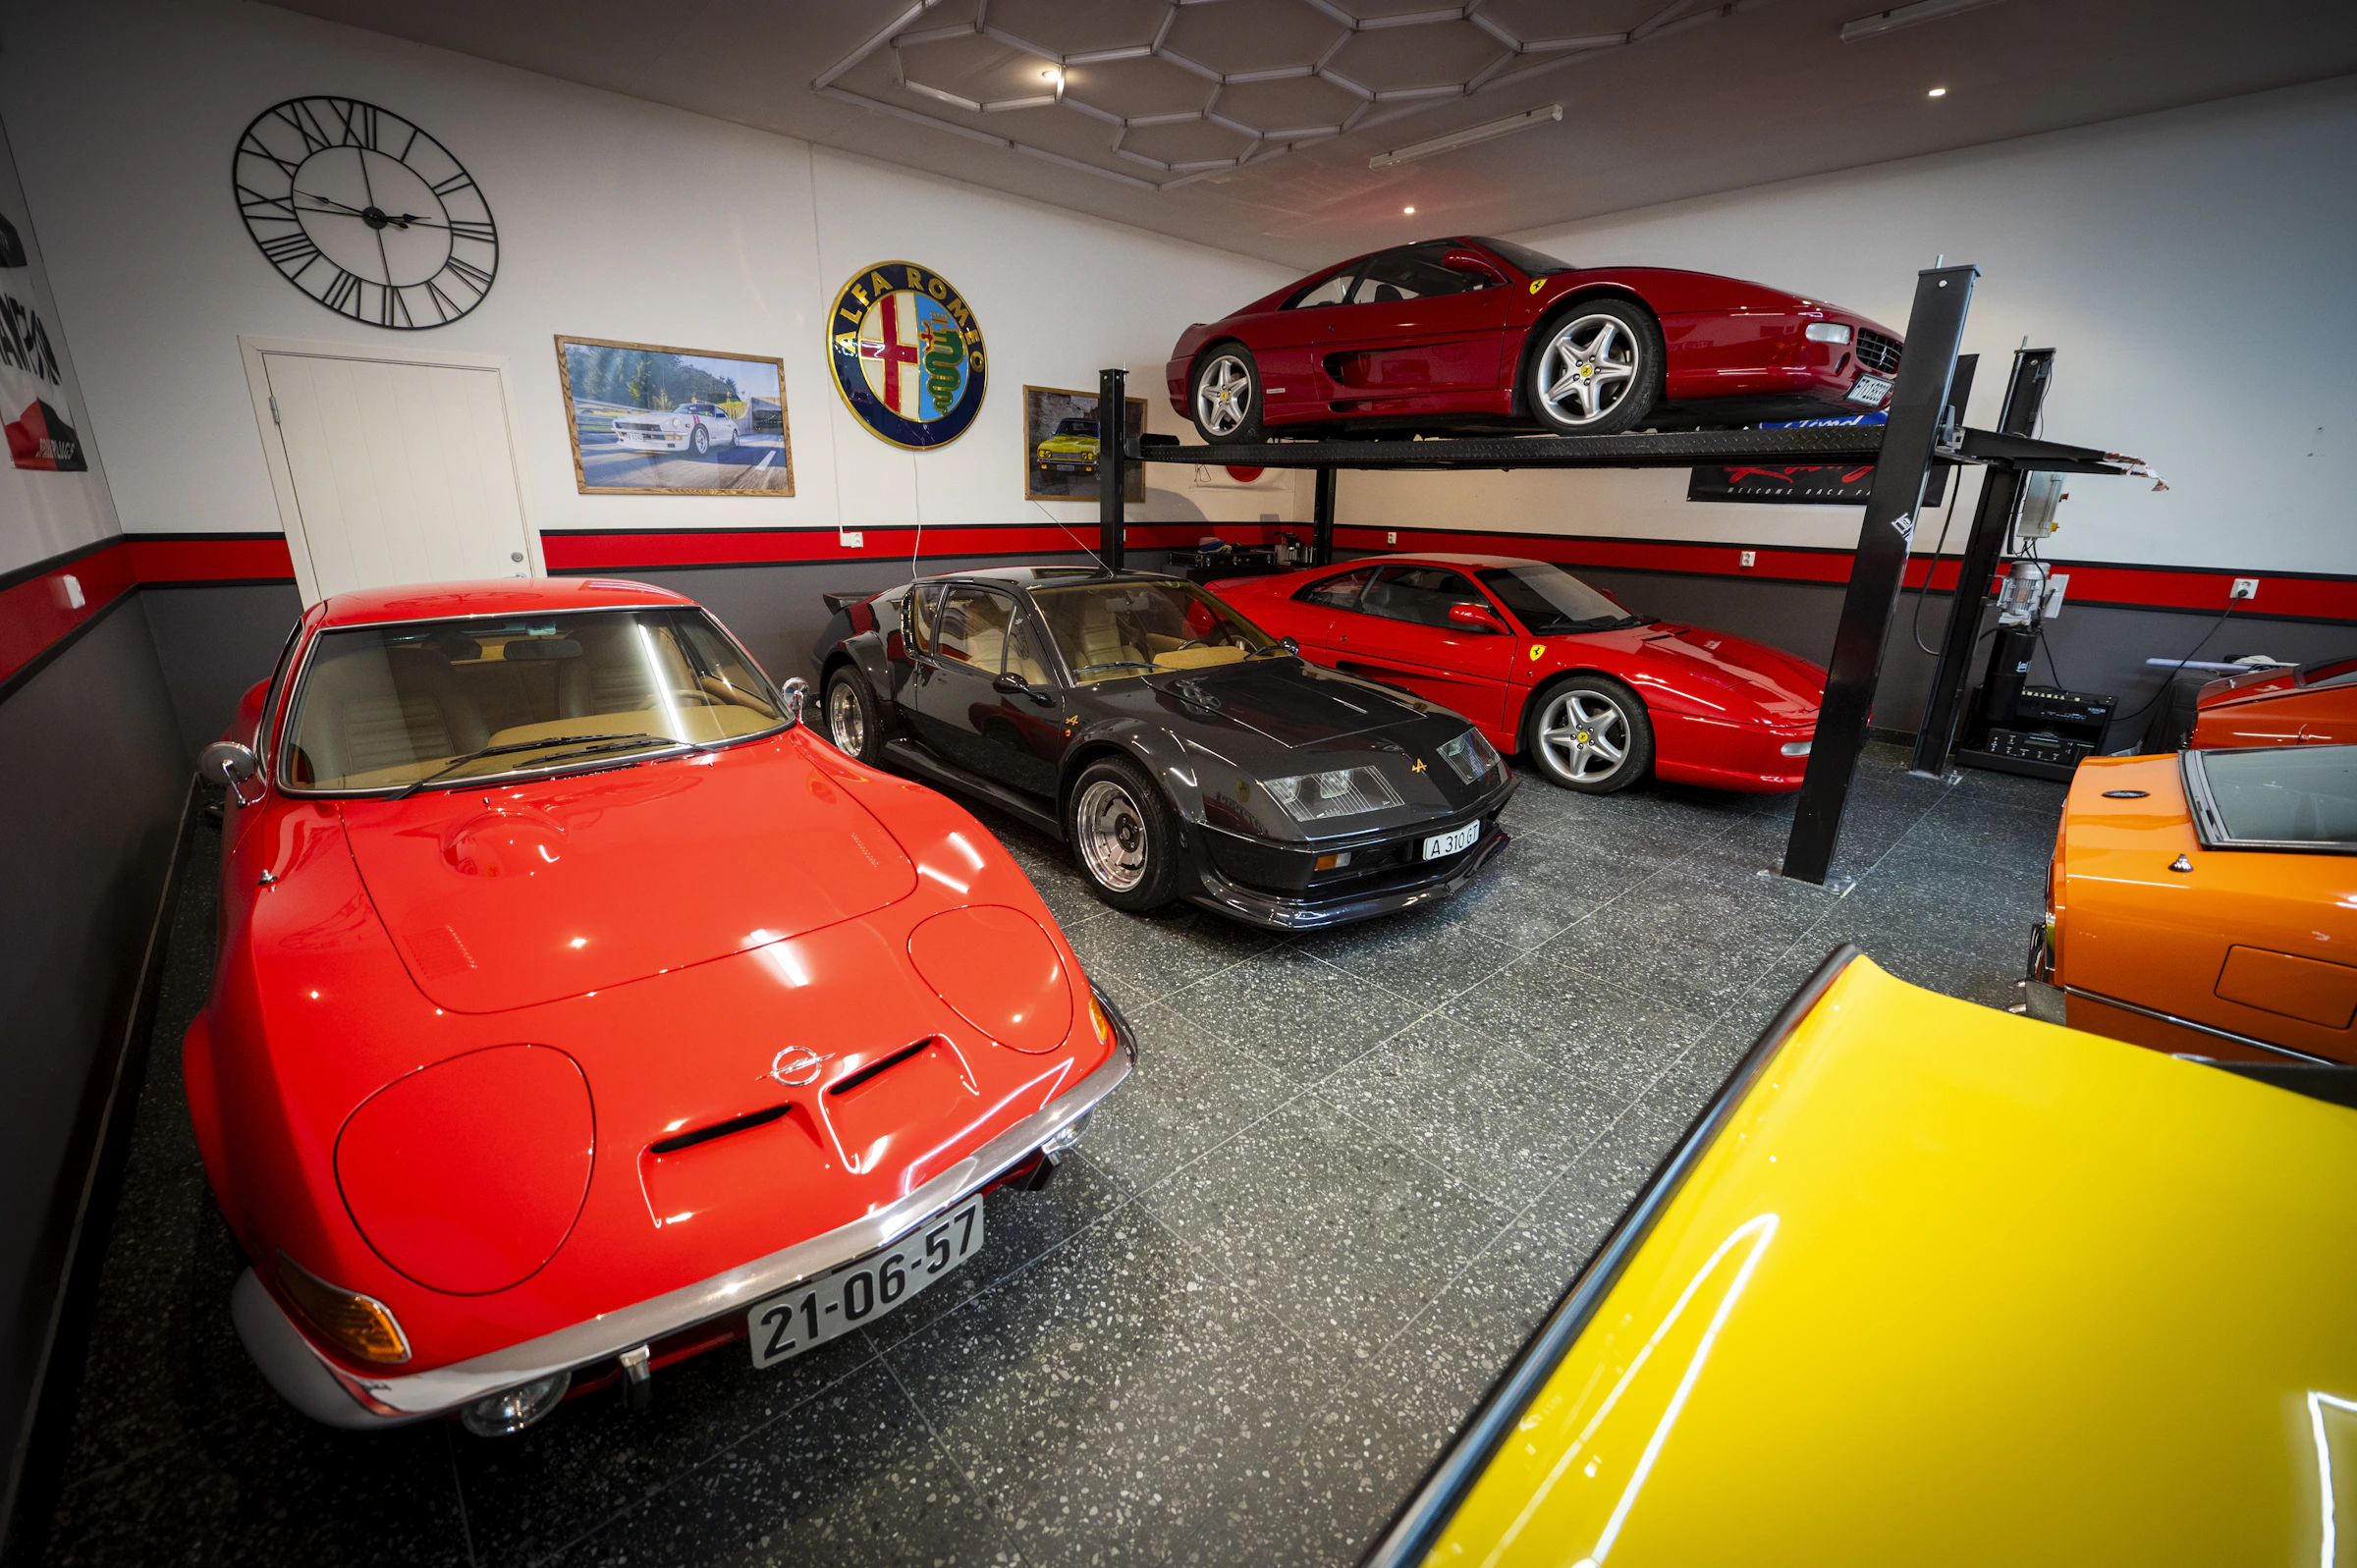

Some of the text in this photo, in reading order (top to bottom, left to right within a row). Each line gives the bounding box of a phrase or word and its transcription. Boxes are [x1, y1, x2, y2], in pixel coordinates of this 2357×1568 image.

[836, 267, 985, 372] ALFA ROMEO
[1431, 825, 1477, 856] A 310 GT
[760, 1204, 976, 1361] 21-06-57
